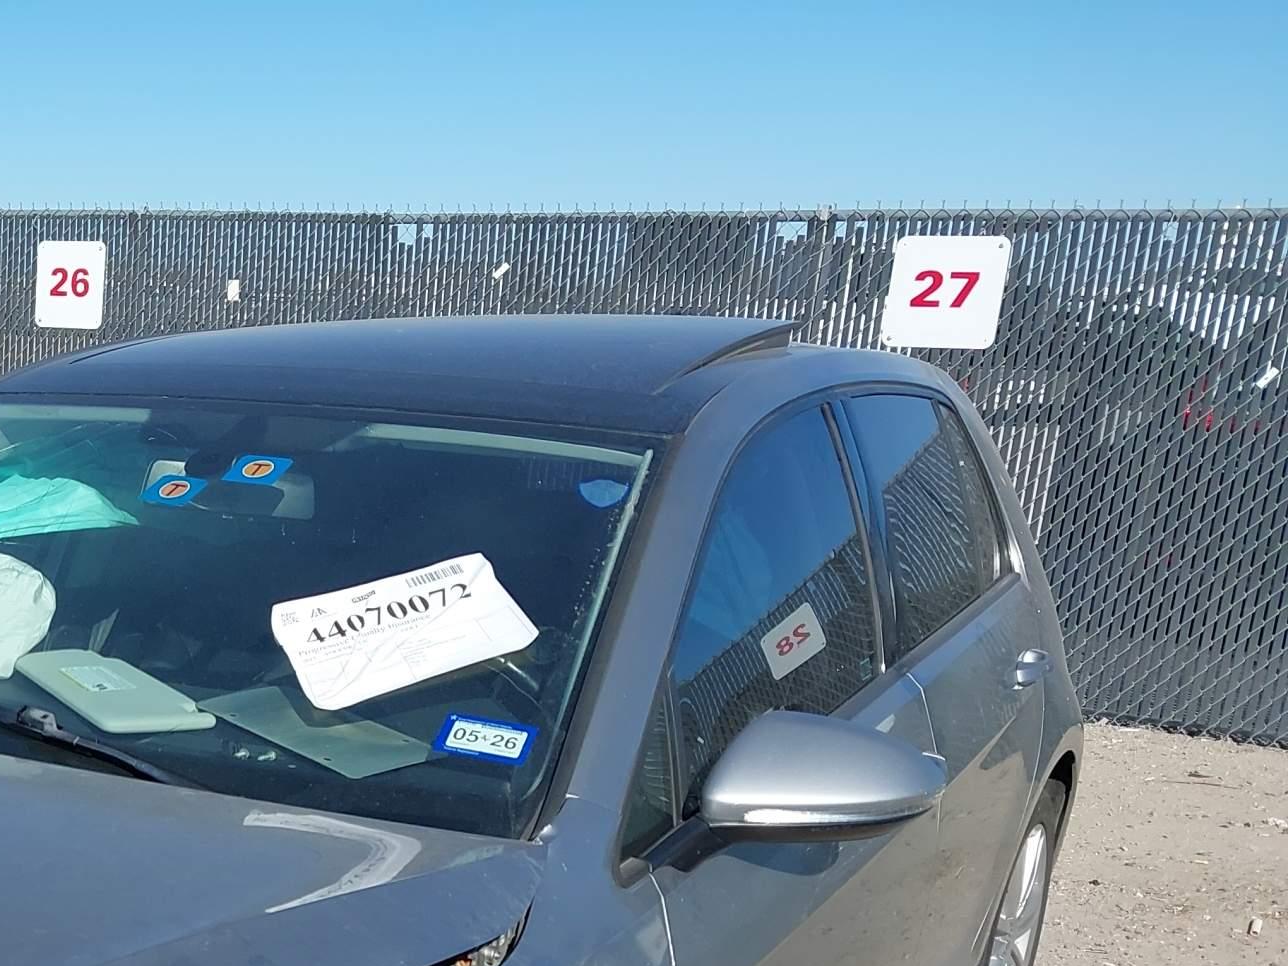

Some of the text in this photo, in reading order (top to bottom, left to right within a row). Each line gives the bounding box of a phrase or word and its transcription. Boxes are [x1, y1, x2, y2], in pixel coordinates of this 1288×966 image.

[49, 267, 90, 299] 26
[908, 269, 981, 309] 27
[306, 582, 473, 643] 44070072
[453, 727, 481, 743] 05
[489, 734, 519, 750] 26
